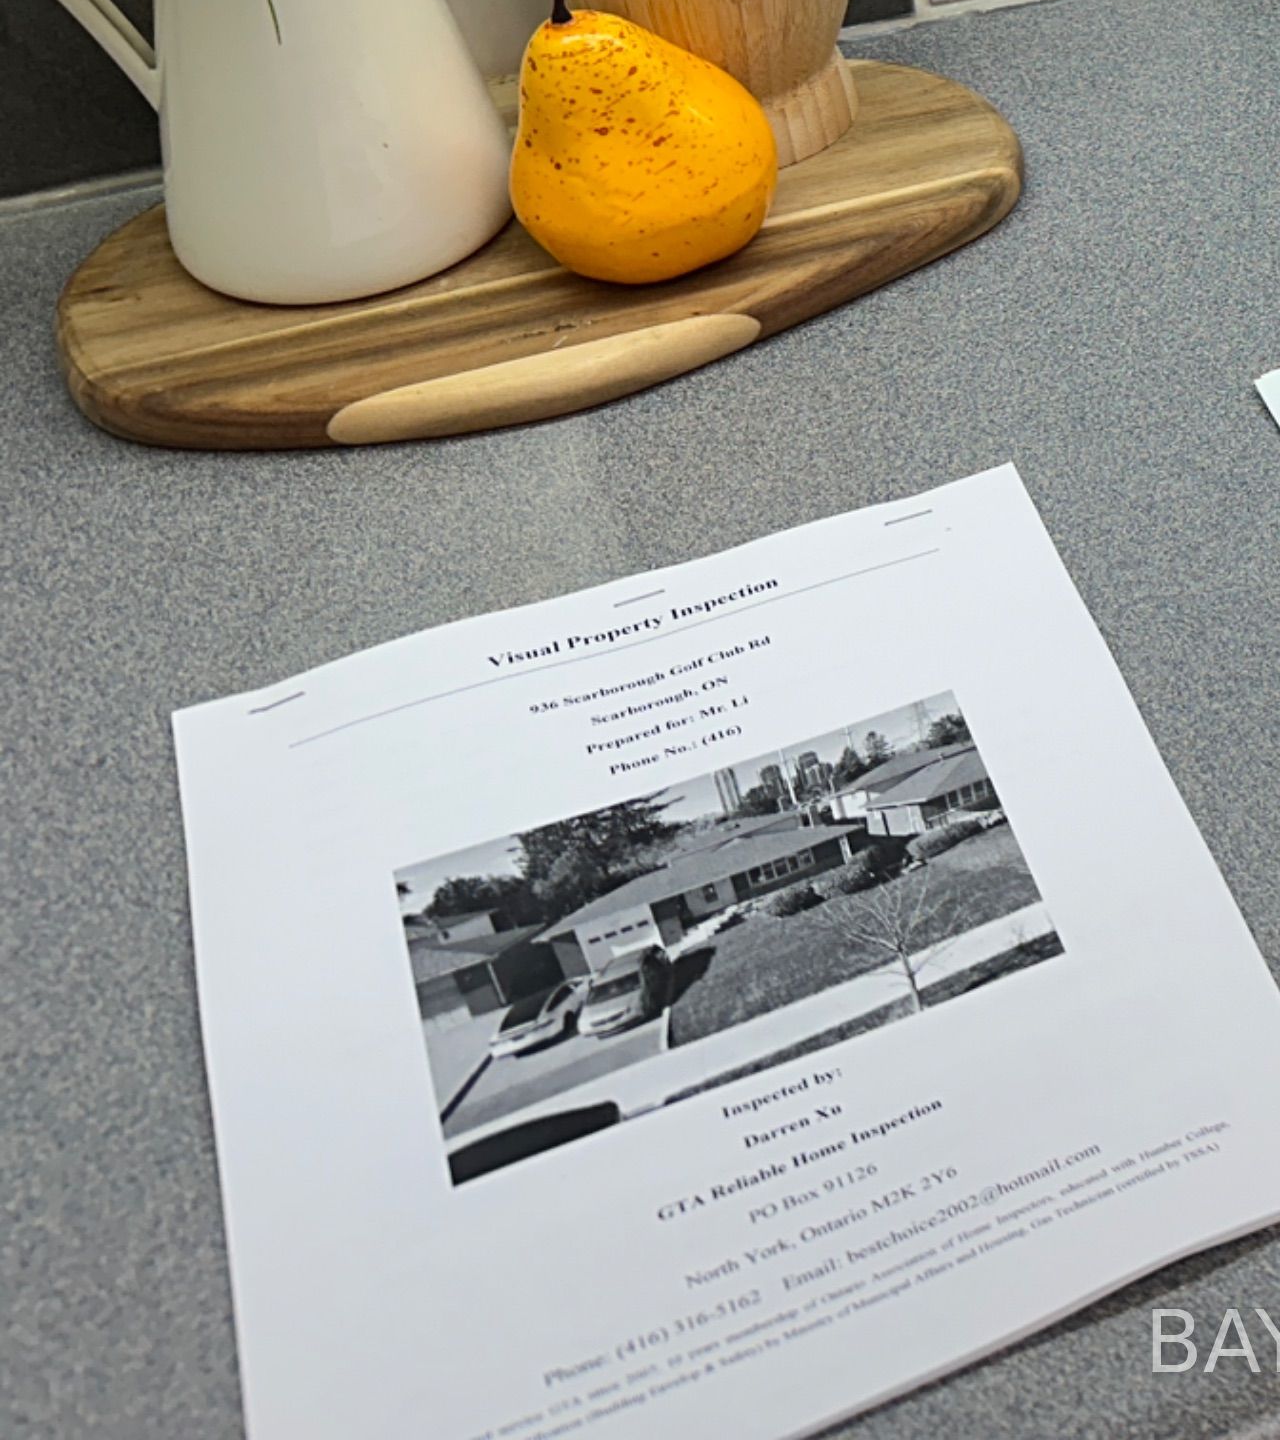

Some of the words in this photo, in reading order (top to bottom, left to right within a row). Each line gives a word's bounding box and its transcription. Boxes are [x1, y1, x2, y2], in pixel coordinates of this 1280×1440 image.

[488, 640, 560, 667] Visual
[567, 618, 661, 649] Property
[670, 579, 779, 620] Inspection
[529, 701, 559, 713] 936
[562, 672, 666, 705] Scarborough
[669, 658, 703, 676] Golf
[707, 645, 745, 664] Club
[748, 635, 771, 650] Rd
[701, 677, 728, 691] ON
[586, 724, 661, 755] Prepared
[665, 716, 694, 731] for:
[731, 695, 749, 708] Li
[609, 754, 659, 775] Phone
[701, 725, 742, 746] (416)
[722, 1077, 809, 1119] Inspected
[812, 1068, 841, 1085] by:
[743, 1117, 811, 1149] Darren
[815, 1105, 842, 1119] Xu
[657, 1195, 705, 1221] GTA
[710, 1164, 786, 1200] Reliable
[791, 1141, 845, 1168] Home
[850, 1100, 943, 1144] Inspection
[1110, 1157, 1137, 1173] with
[748, 1203, 779, 1225] PO
[781, 1190, 820, 1211] Box
[822, 1164, 878, 1193] 91126
[684, 1259, 741, 1289] North
[743, 1238, 797, 1265] York,
[799, 1208, 868, 1243] Ontario
[870, 1183, 916, 1213] M2K
[922, 1167, 958, 1191] 2Y6
[543, 1355, 608, 1388] Phone:
[615, 1327, 670, 1361] (416)
[673, 1289, 762, 1335] 316-5162
[781, 1257, 842, 1292] Email:
[845, 1144, 1101, 1265] bestchoice2002@hotmail.com
